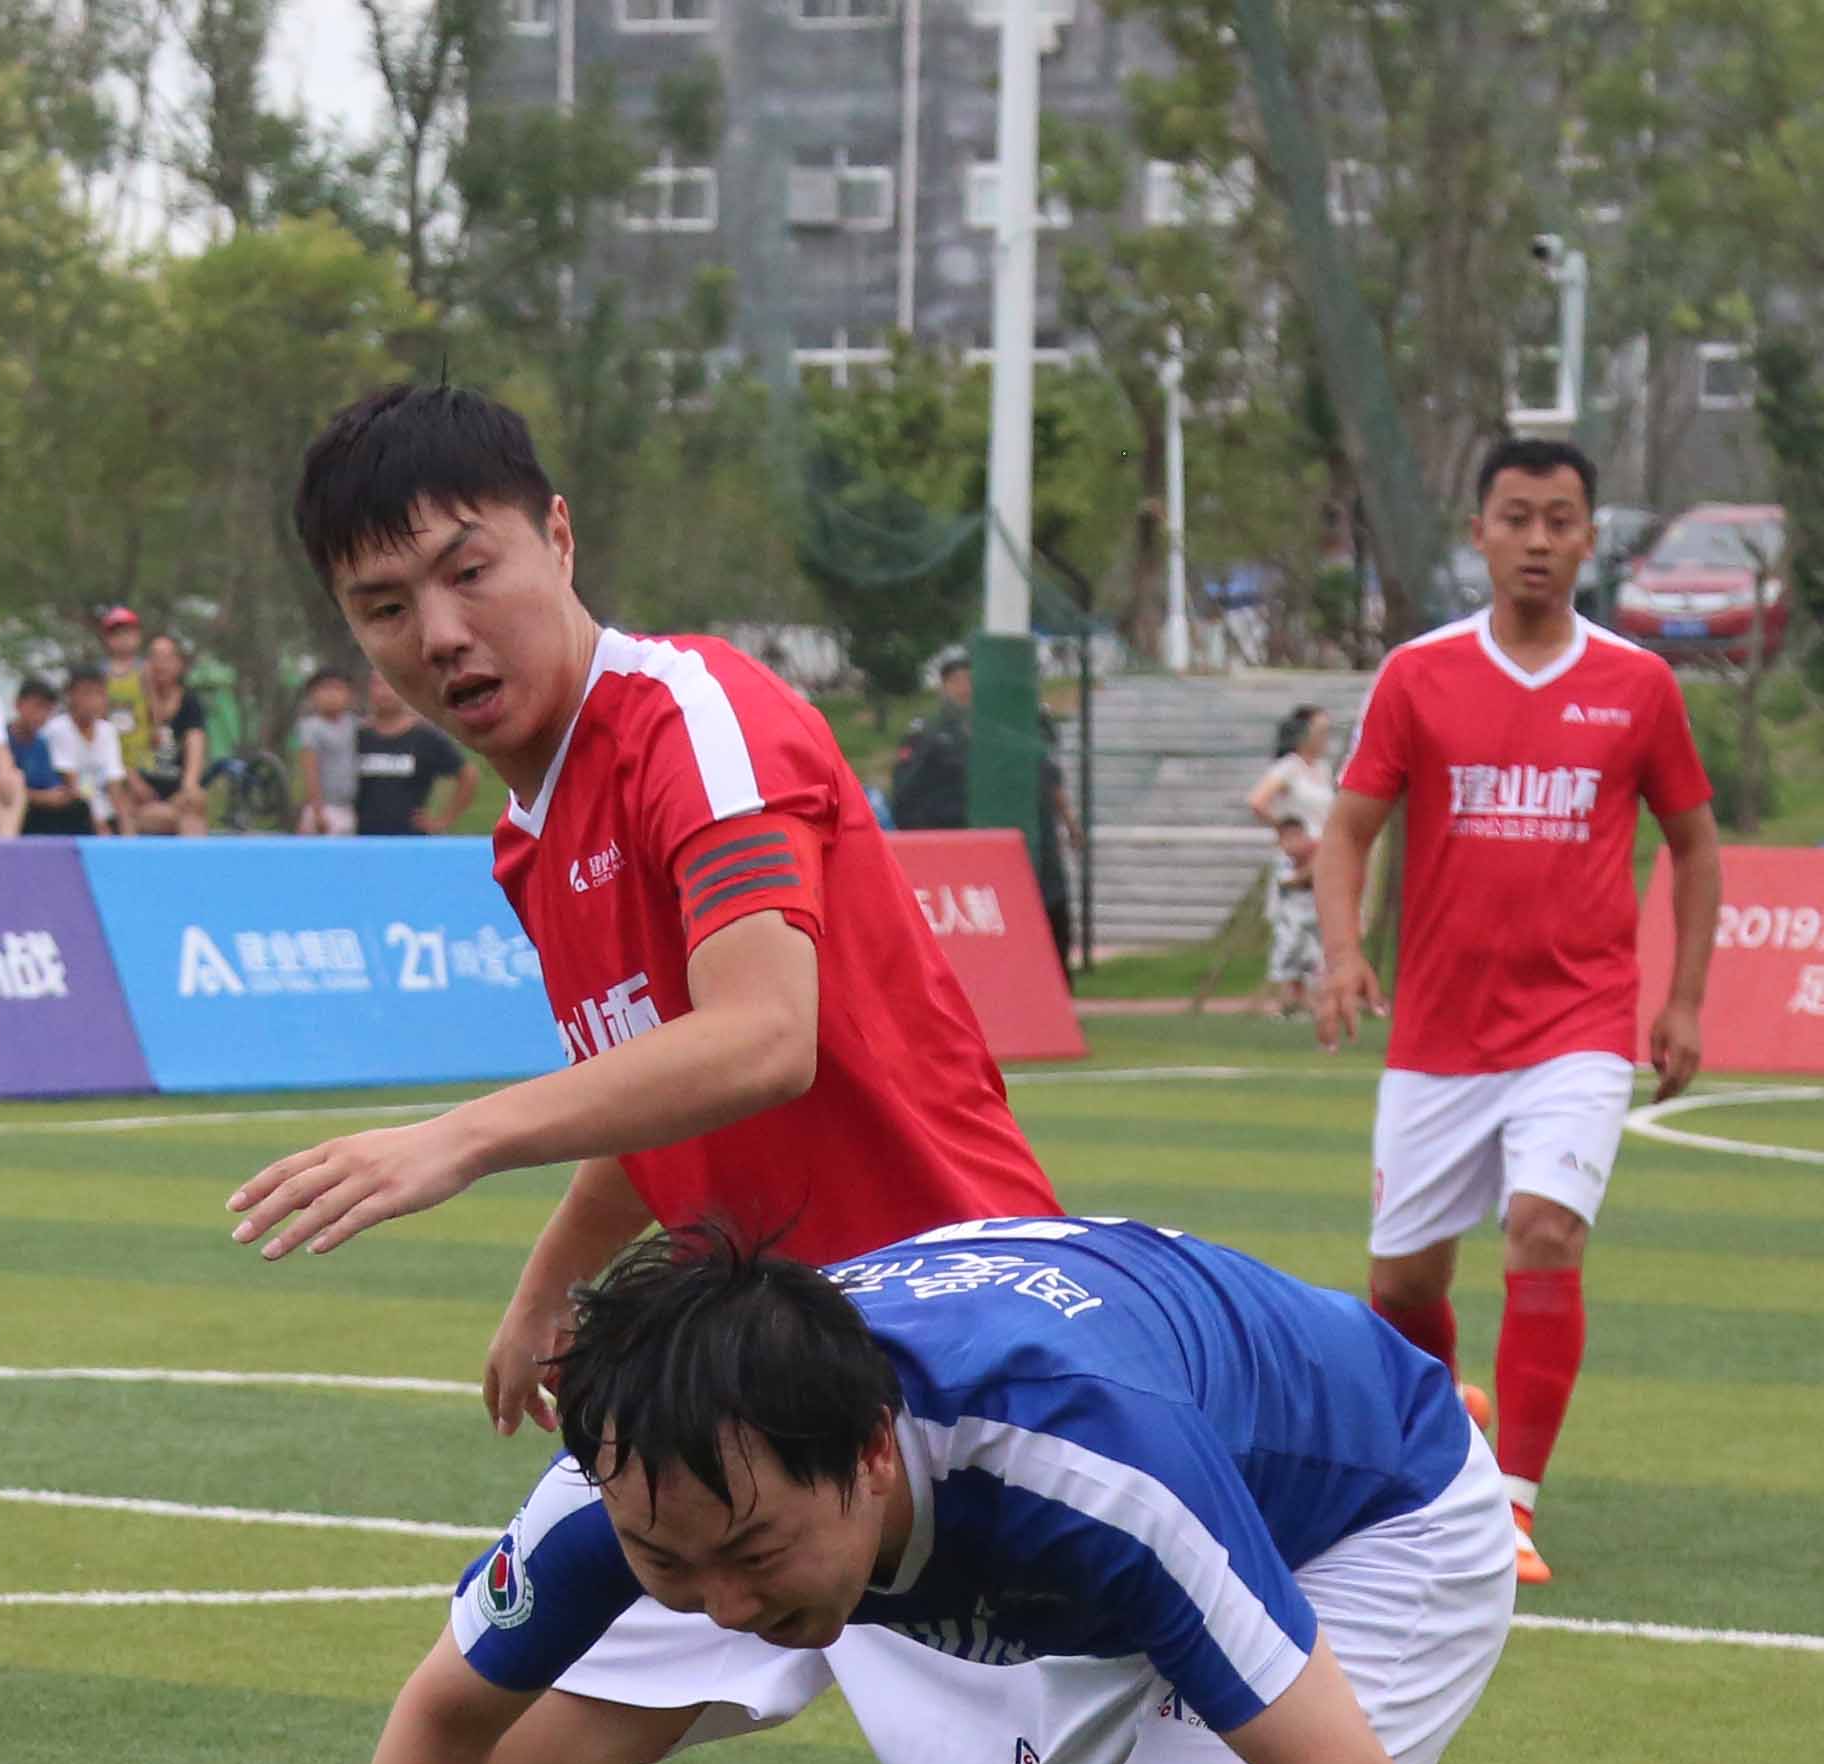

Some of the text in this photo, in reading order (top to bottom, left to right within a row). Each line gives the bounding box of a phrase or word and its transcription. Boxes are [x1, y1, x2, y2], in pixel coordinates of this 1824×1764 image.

[1449, 765, 1603, 818] 建业杯
[384, 921, 448, 990] 27
